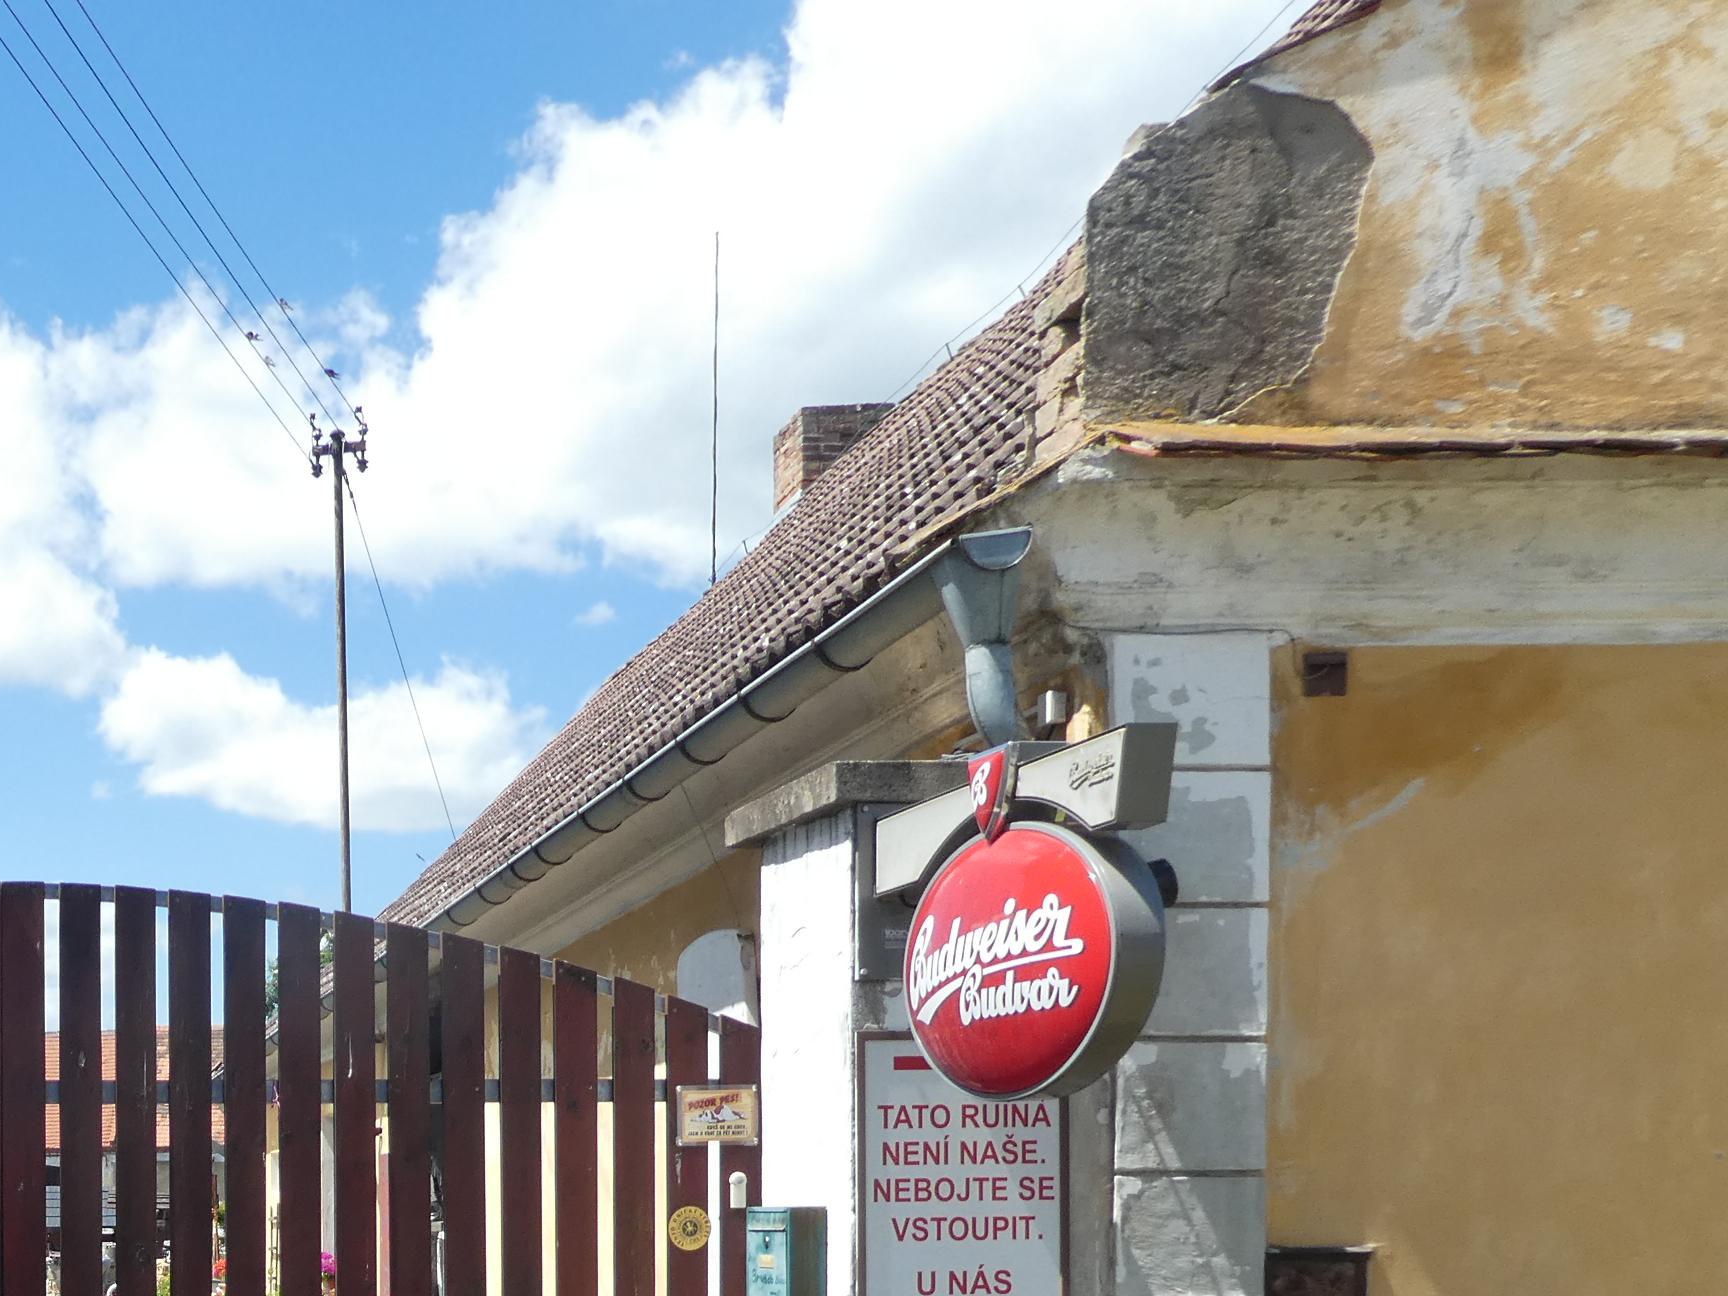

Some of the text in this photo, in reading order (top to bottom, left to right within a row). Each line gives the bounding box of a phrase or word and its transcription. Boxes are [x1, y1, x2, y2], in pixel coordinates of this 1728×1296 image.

[910, 893, 1084, 1011] Budweiser
[959, 964, 1079, 1026] Budvar
[877, 1103, 1051, 1129] TATO RUINA
[882, 1134, 1046, 1165] NENÍ NAŠE.
[873, 1176, 1055, 1203] NEBOJTE SE
[892, 1216, 1043, 1241] VSTOUPIT.
[917, 1264, 1012, 1296] U NÁS
